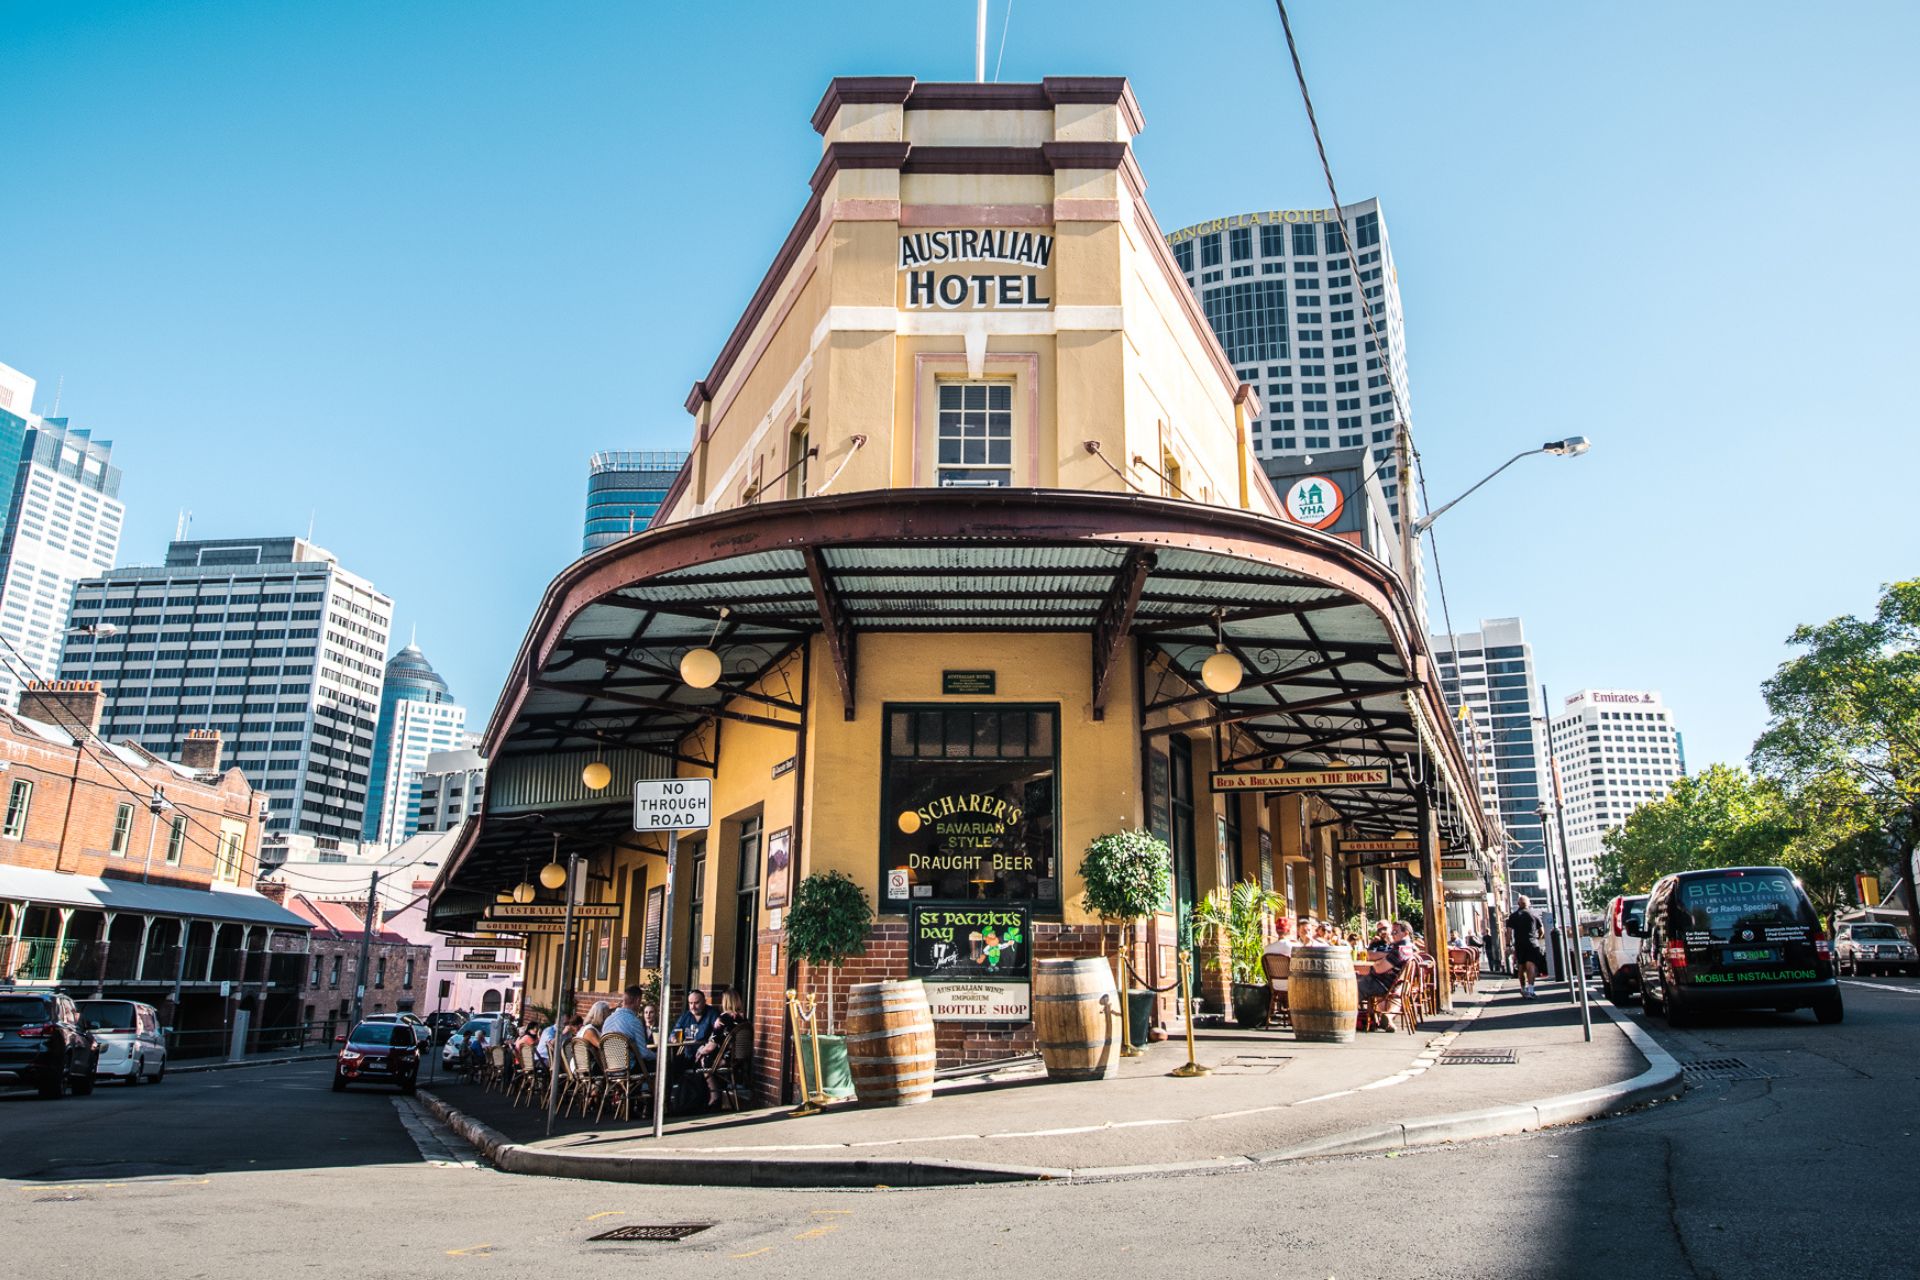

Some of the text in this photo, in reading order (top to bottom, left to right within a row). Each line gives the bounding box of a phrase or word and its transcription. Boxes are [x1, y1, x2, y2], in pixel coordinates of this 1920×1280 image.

[1268, 209, 1332, 224] HOTEL
[899, 229, 1054, 270] AUSTRALIAN
[905, 270, 1050, 309] HOTEL
[1300, 505, 1325, 515] YHA
[1593, 692, 1639, 703] Emirates
[1237, 777, 1246, 786] &
[1320, 772, 1343, 784] THE
[1346, 771, 1383, 783] ROCKS
[663, 783, 684, 795] NO
[640, 798, 706, 811] THROUGH
[917, 793, 1023, 826] SCHARER'S
[650, 814, 695, 826] ROAD
[936, 822, 1005, 835] BAVARIAN
[949, 836, 993, 848] STYLE
[1350, 842, 1396, 850] GOURMET
[909, 853, 1033, 870] DRAUGHT BEER
[1688, 880, 1786, 898] BENDAS
[577, 907, 611, 915] HOTEL
[1706, 903, 1778, 914] Car Radio Specialist
[1695, 969, 1817, 983] MOBILE INSTALLATIONS
[936, 985, 1005, 995] AUSTRALIAN WINE
[938, 1004, 987, 1014] BOTTLE
[993, 1004, 1027, 1014] SHOP
